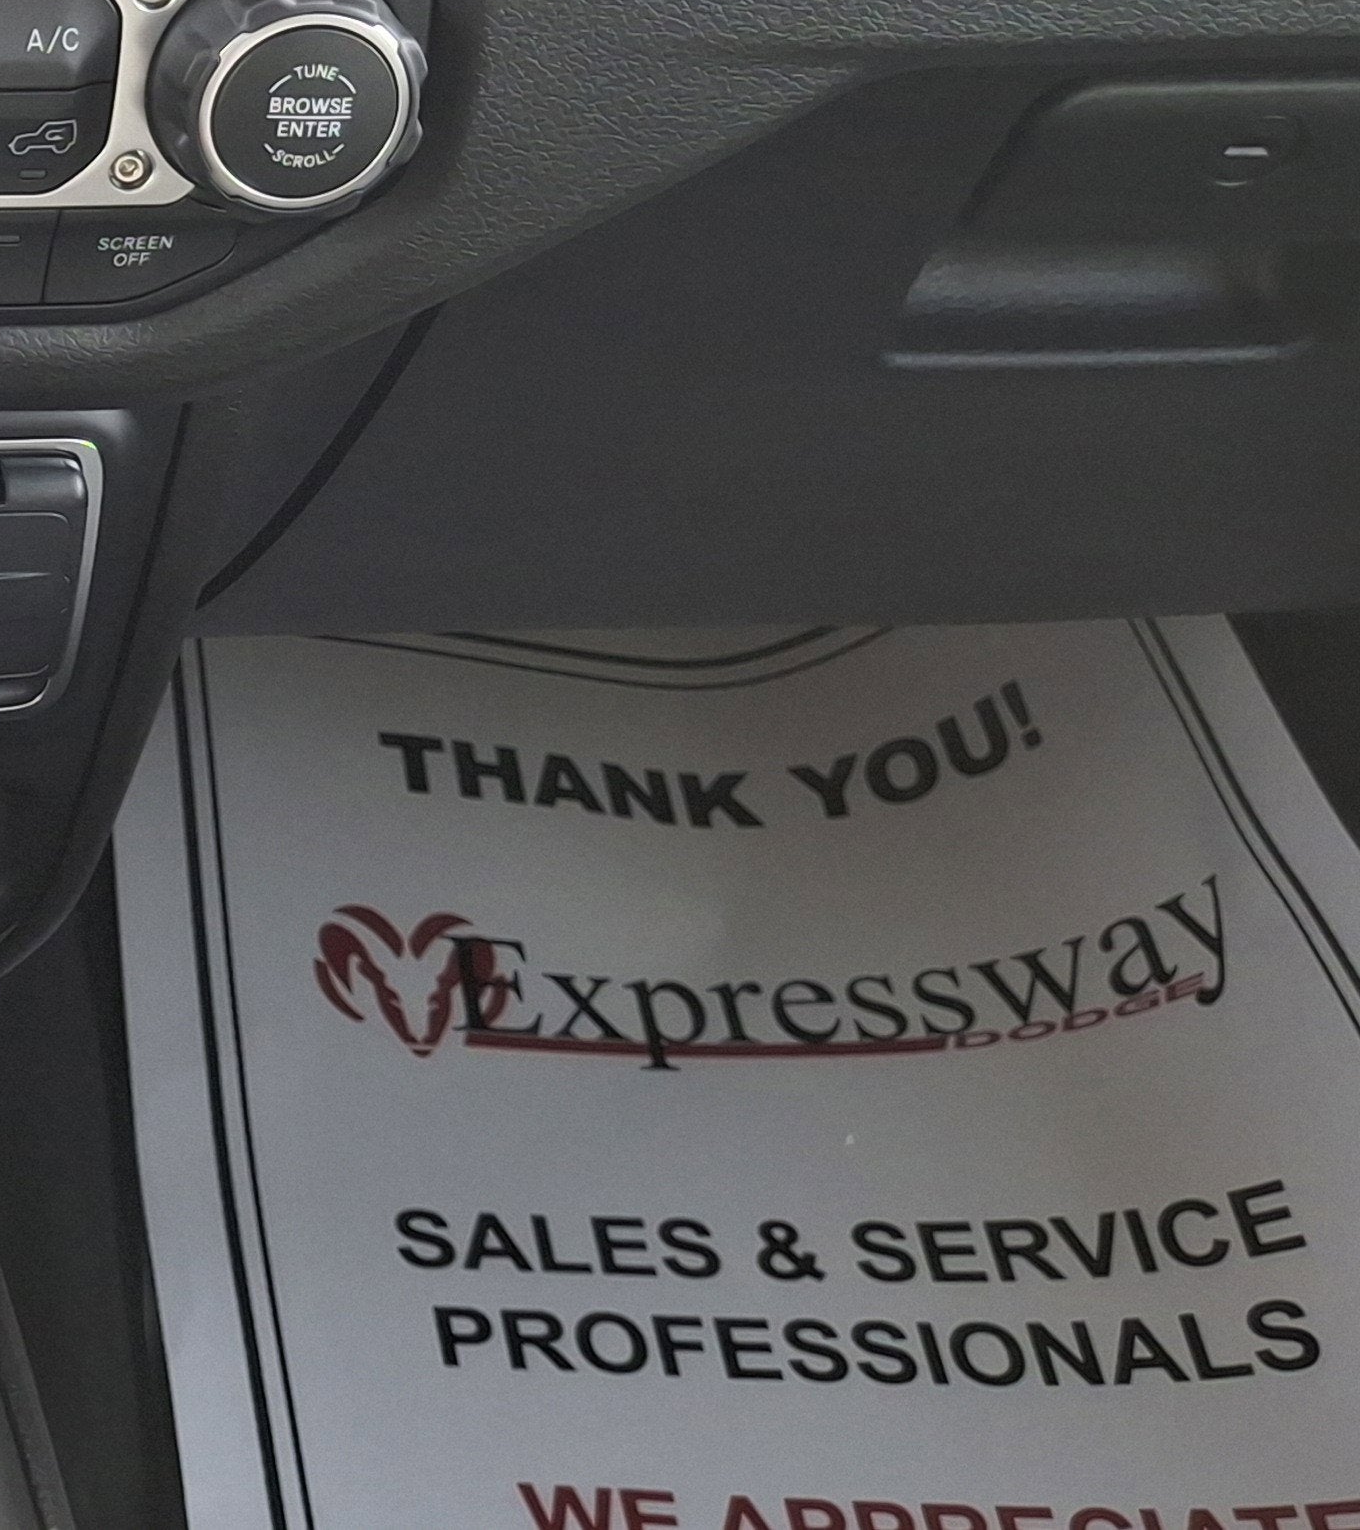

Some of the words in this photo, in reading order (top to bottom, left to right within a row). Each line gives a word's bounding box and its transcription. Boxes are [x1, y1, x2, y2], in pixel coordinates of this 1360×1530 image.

[27, 26, 79, 54] A/C
[293, 63, 340, 82] TUNE
[268, 97, 353, 115] BROWSE
[276, 121, 341, 138] ENTER
[272, 148, 336, 168] SCROLL
[97, 236, 174, 252] SCREEN
[113, 252, 150, 267] OFF
[377, 731, 764, 830] THANK
[789, 680, 1044, 820] YOU!
[440, 873, 1229, 1071] Expressway
[392, 1208, 721, 1282] SALES
[756, 1219, 825, 1282] &
[850, 1178, 1307, 1284] SERVICE
[432, 1300, 1323, 1388] PROFESSIONALS
